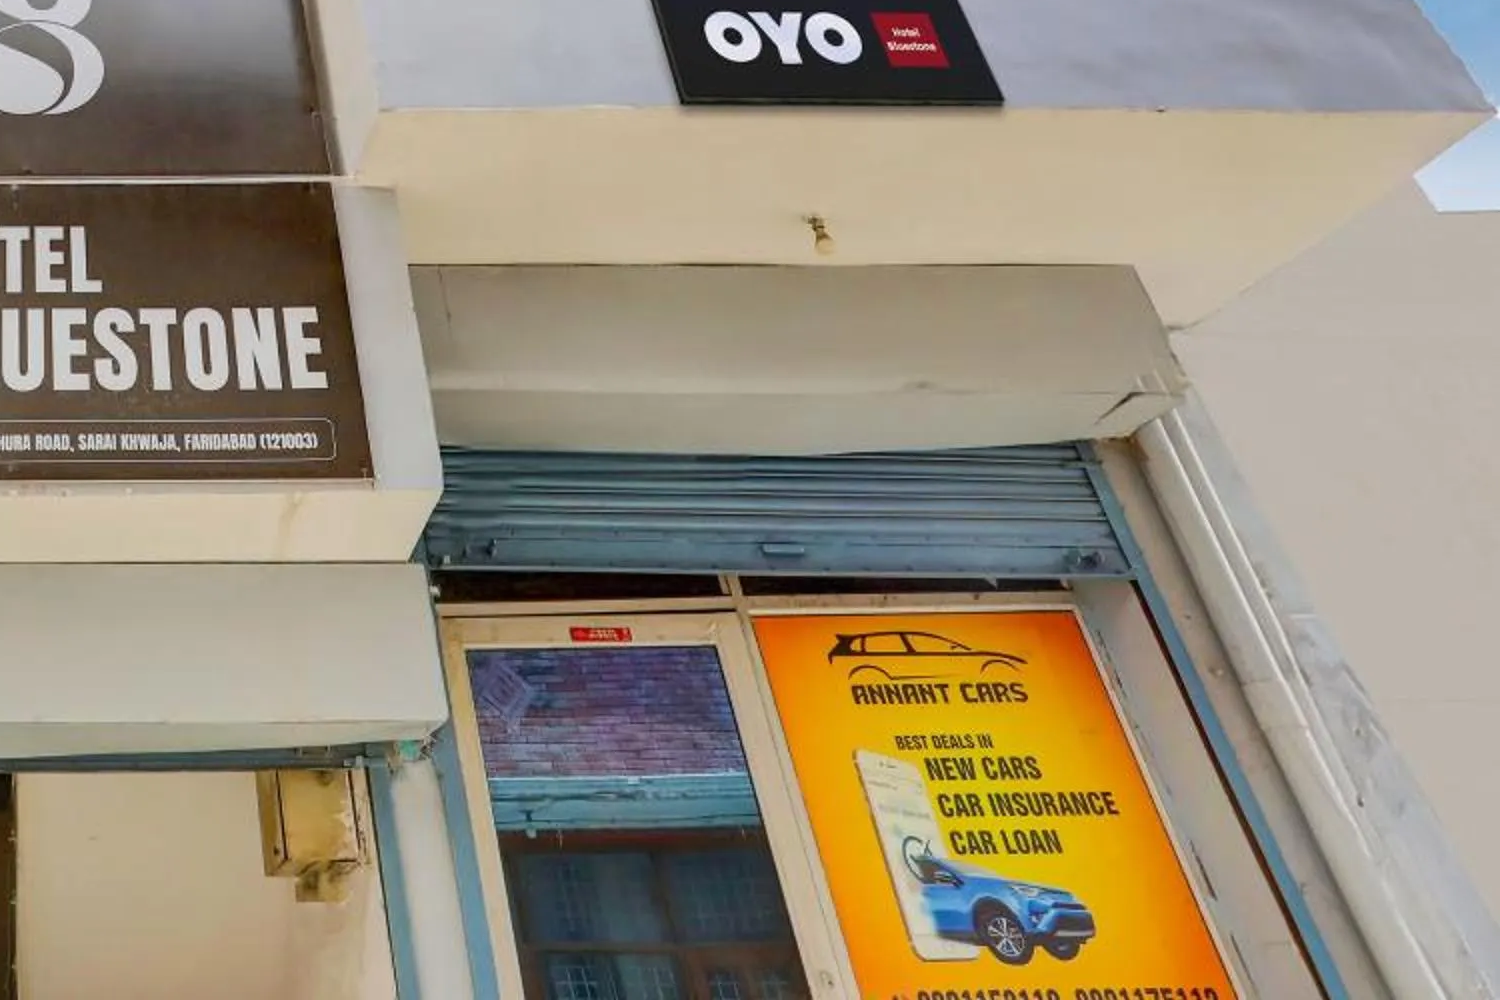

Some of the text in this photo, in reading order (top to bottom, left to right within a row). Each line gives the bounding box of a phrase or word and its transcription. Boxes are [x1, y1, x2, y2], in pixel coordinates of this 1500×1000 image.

[703, 10, 863, 65] OYO
[35, 433, 75, 453] ROAD,
[77, 433, 117, 452] SARAI
[120, 433, 181, 453] KHWAJA,
[184, 433, 256, 451] FARIDABAD
[260, 432, 319, 450] (121003)
[851, 682, 1029, 704] ANNANT CARS
[895, 733, 994, 750] BEST DEALS IN
[924, 756, 1042, 780] NEW CARS
[937, 793, 985, 817] CAR
[988, 791, 1120, 817] INSURANCE
[949, 829, 1063, 855] CAR LOAN
